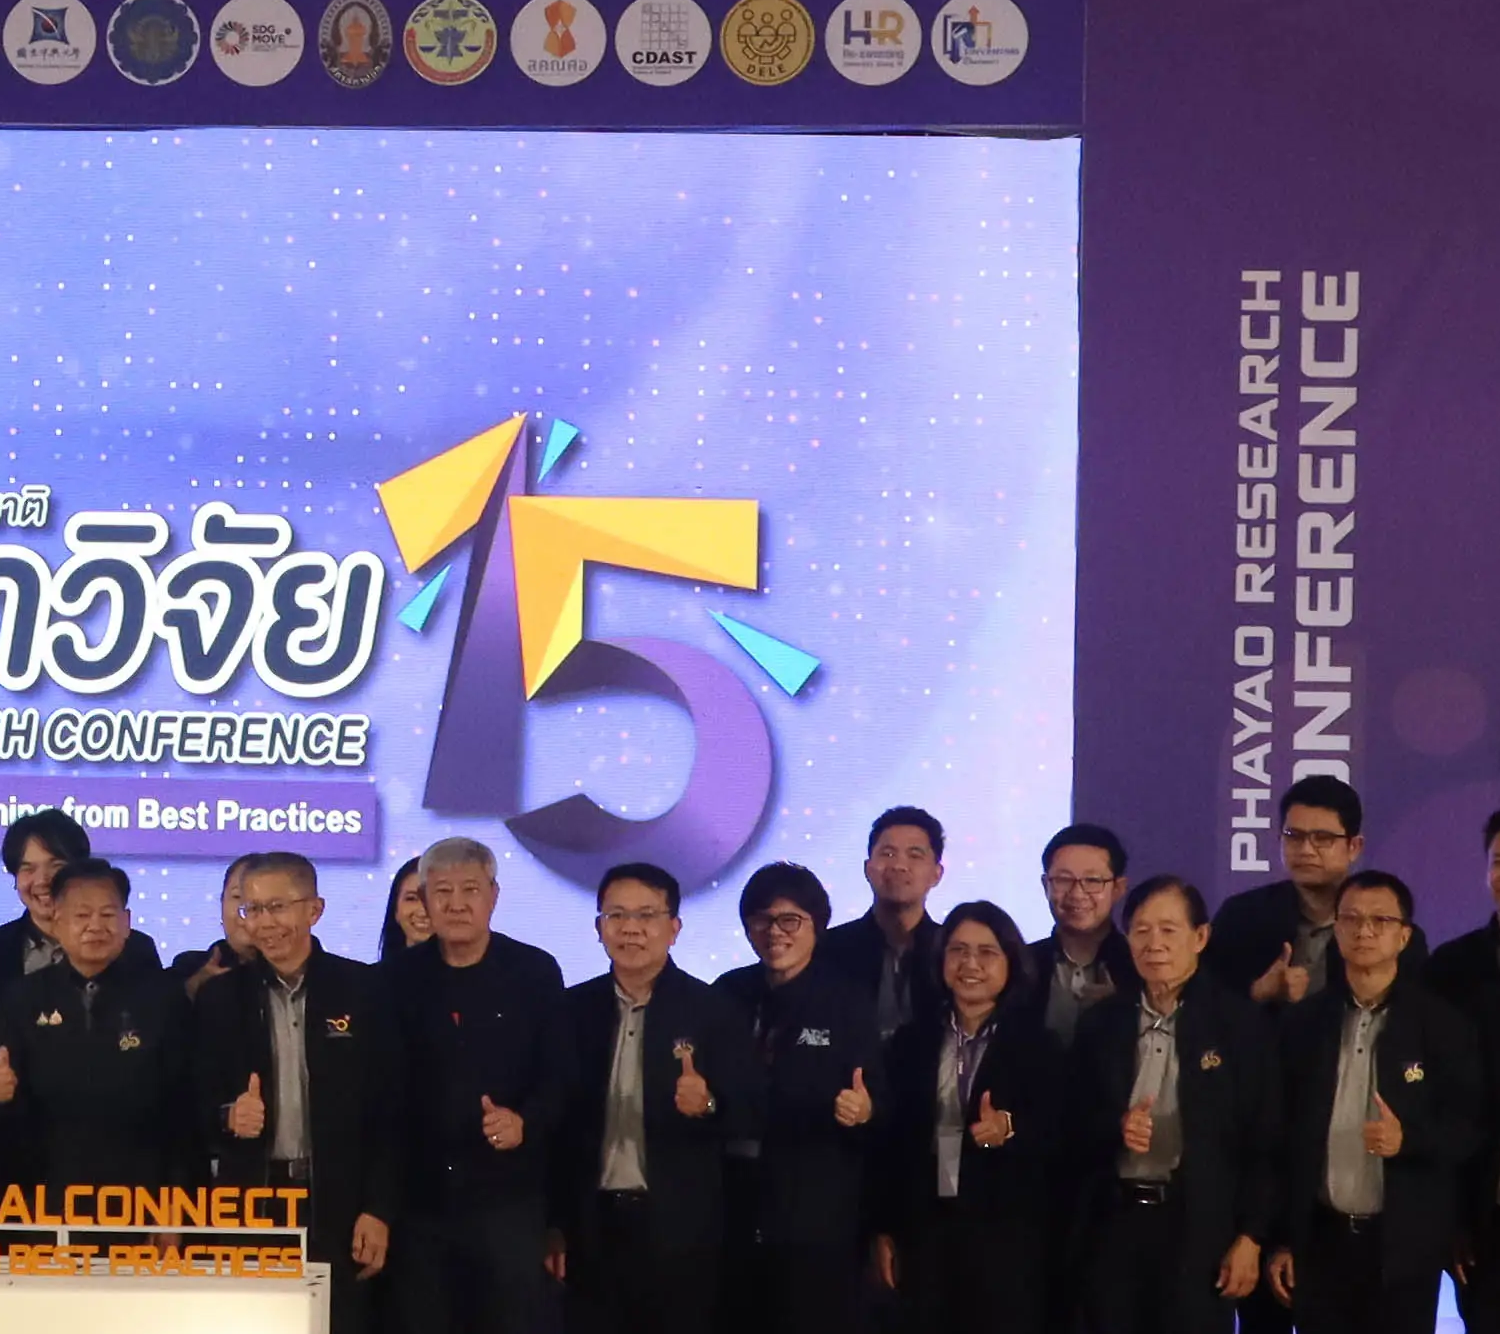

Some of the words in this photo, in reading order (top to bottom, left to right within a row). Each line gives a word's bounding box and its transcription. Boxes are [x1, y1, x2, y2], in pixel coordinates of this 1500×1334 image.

[632, 51, 697, 64] CDAST
[1236, 269, 1282, 603] RESEARCH
[43, 713, 368, 766] CONFERENCE
[1231, 626, 1274, 872] PHAYAO
[138, 799, 208, 830] Best
[217, 803, 362, 834] Practices
[7, 1243, 99, 1276] BEST
[108, 1244, 304, 1279] PRACTICES
